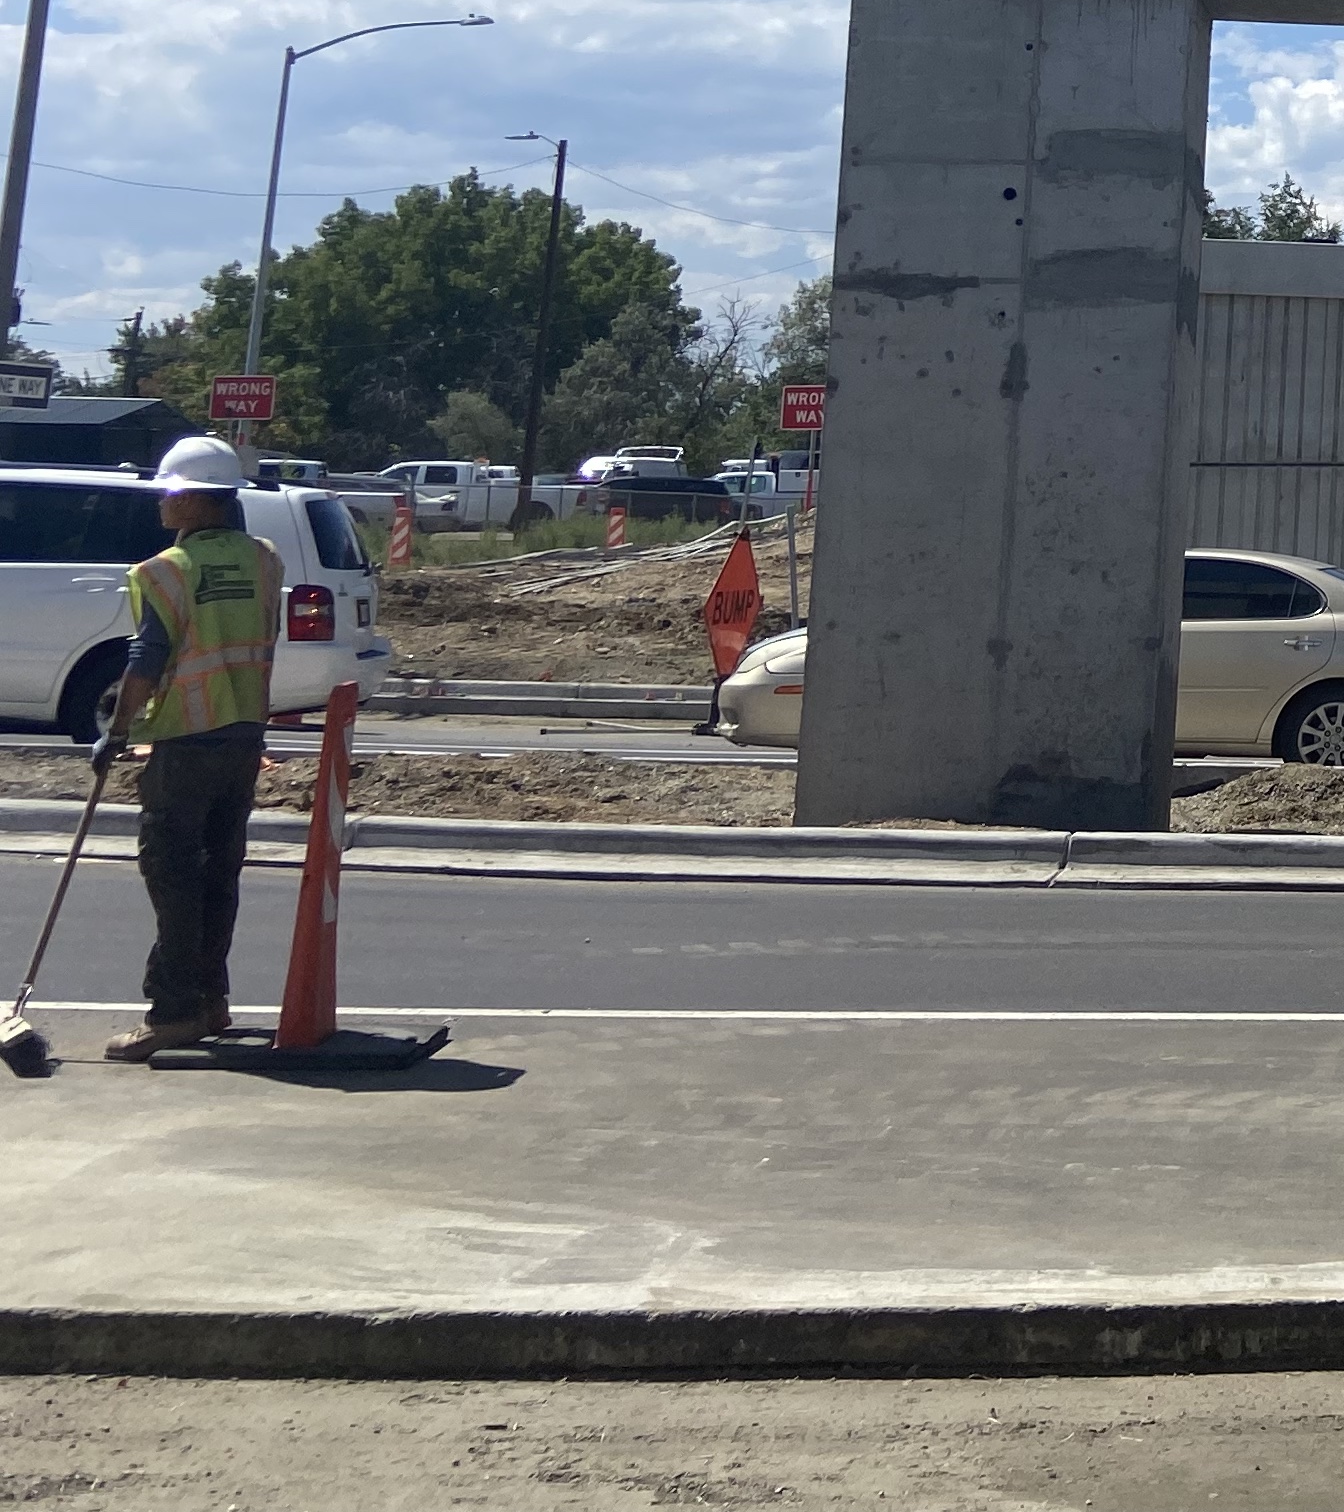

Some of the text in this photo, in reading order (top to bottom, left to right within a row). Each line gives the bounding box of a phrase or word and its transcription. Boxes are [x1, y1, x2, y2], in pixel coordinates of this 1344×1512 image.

[19, 378, 45, 396] WAY
[216, 382, 271, 396] WRONG
[224, 399, 259, 413] WAY
[711, 589, 756, 626] BUMP
